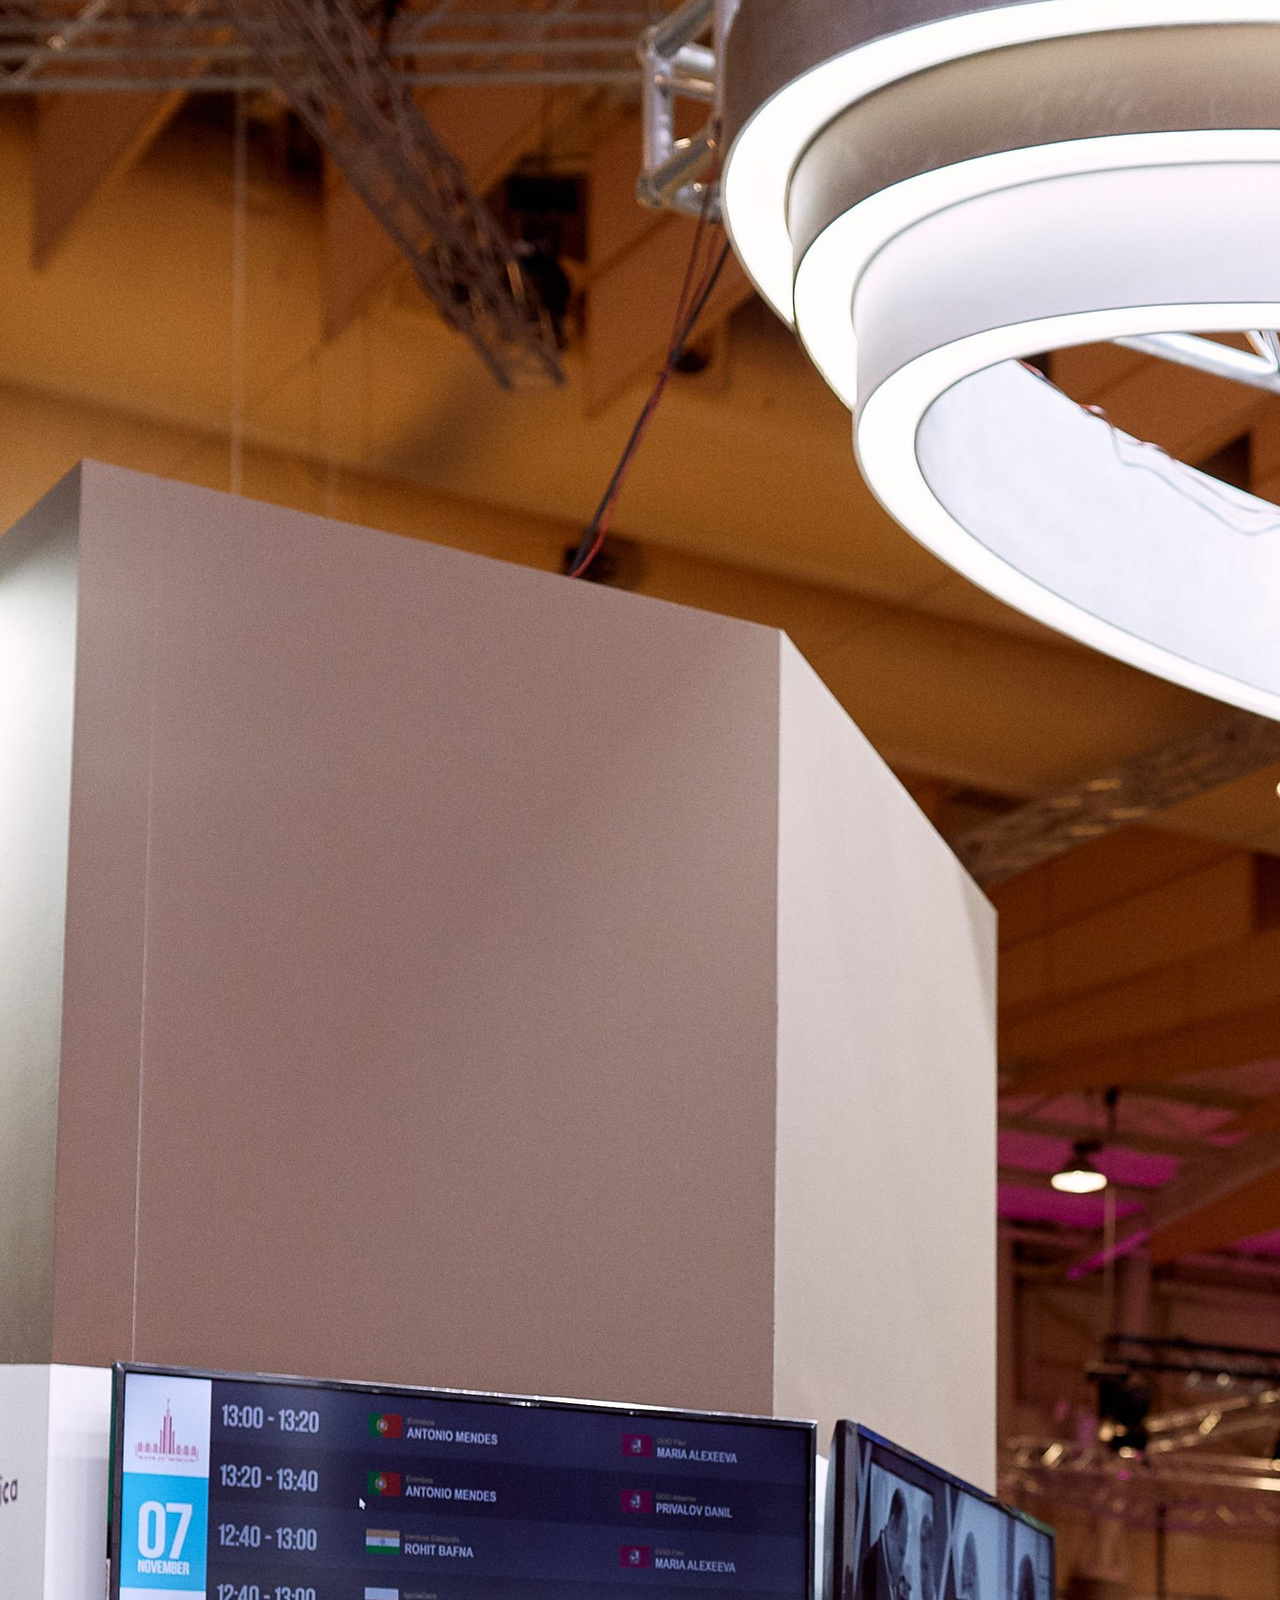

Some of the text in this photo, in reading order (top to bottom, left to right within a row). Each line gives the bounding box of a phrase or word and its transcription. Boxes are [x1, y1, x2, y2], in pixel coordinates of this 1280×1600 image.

[222, 1405, 263, 1428] 13:00
[278, 1409, 319, 1433] 13:20
[406, 1427, 498, 1445] ANTONIO MENDES
[657, 1447, 737, 1463] MARIA ALEXEEVA
[220, 1465, 261, 1488] 13:20
[277, 1469, 318, 1492] 13:40
[405, 1485, 497, 1503] ANTONIO MENDES
[656, 1503, 733, 1518] PRIVALOV DANIL
[138, 1500, 193, 1560] 07
[219, 1524, 260, 1547] 12:40
[276, 1528, 317, 1551] 13:00
[405, 1543, 473, 1558] ROHIT BAFNA
[138, 1559, 190, 1575] NOVEMBER
[655, 1558, 736, 1573] MARIA ALEXEEVA
